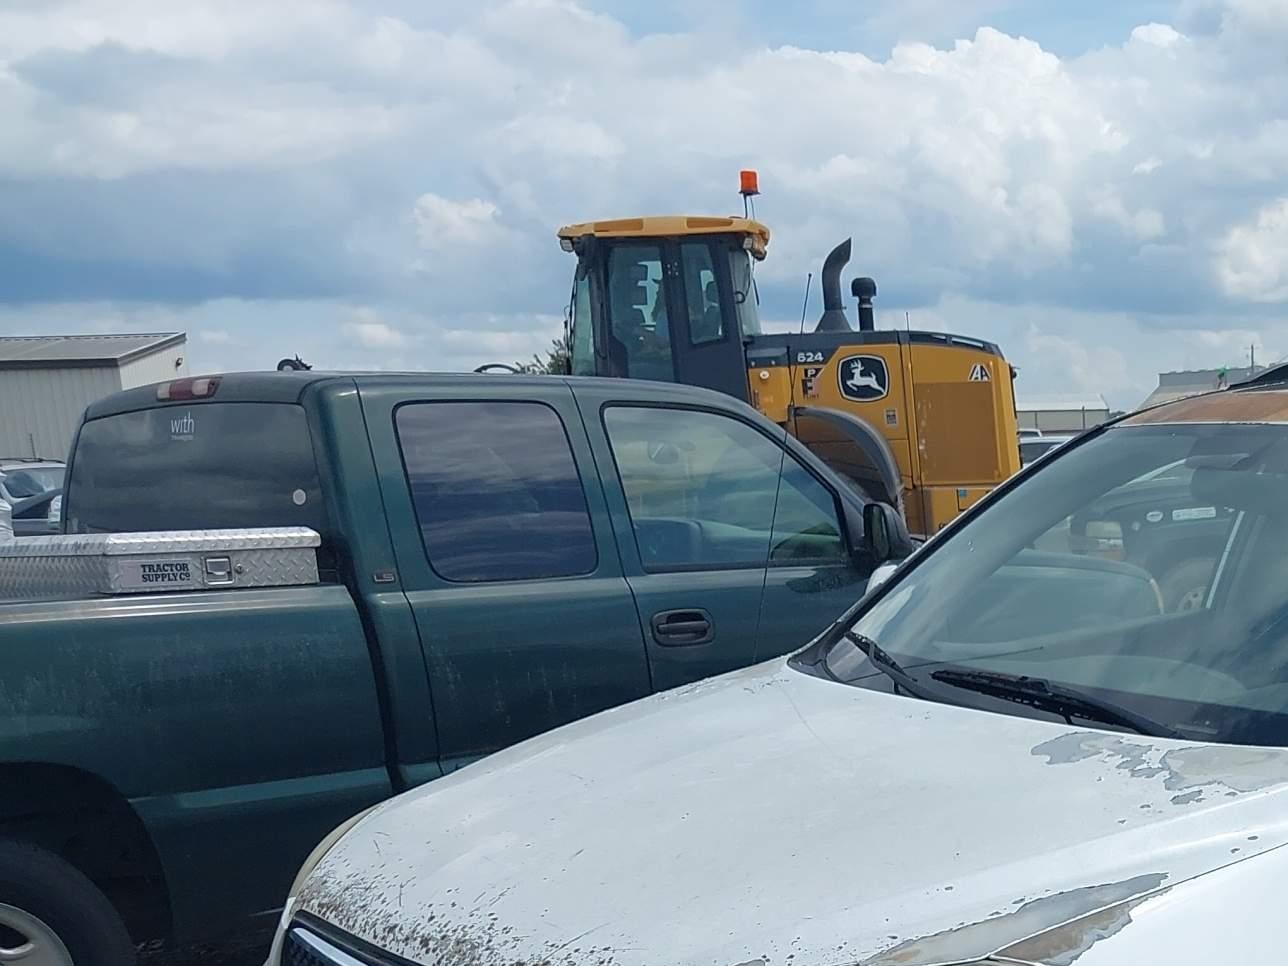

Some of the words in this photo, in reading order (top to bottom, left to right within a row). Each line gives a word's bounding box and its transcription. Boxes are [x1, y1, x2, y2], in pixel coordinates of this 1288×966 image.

[797, 351, 824, 363] 624
[170, 411, 195, 433] with
[141, 563, 190, 573] TRACTOR
[142, 572, 178, 582] SUPPLY
